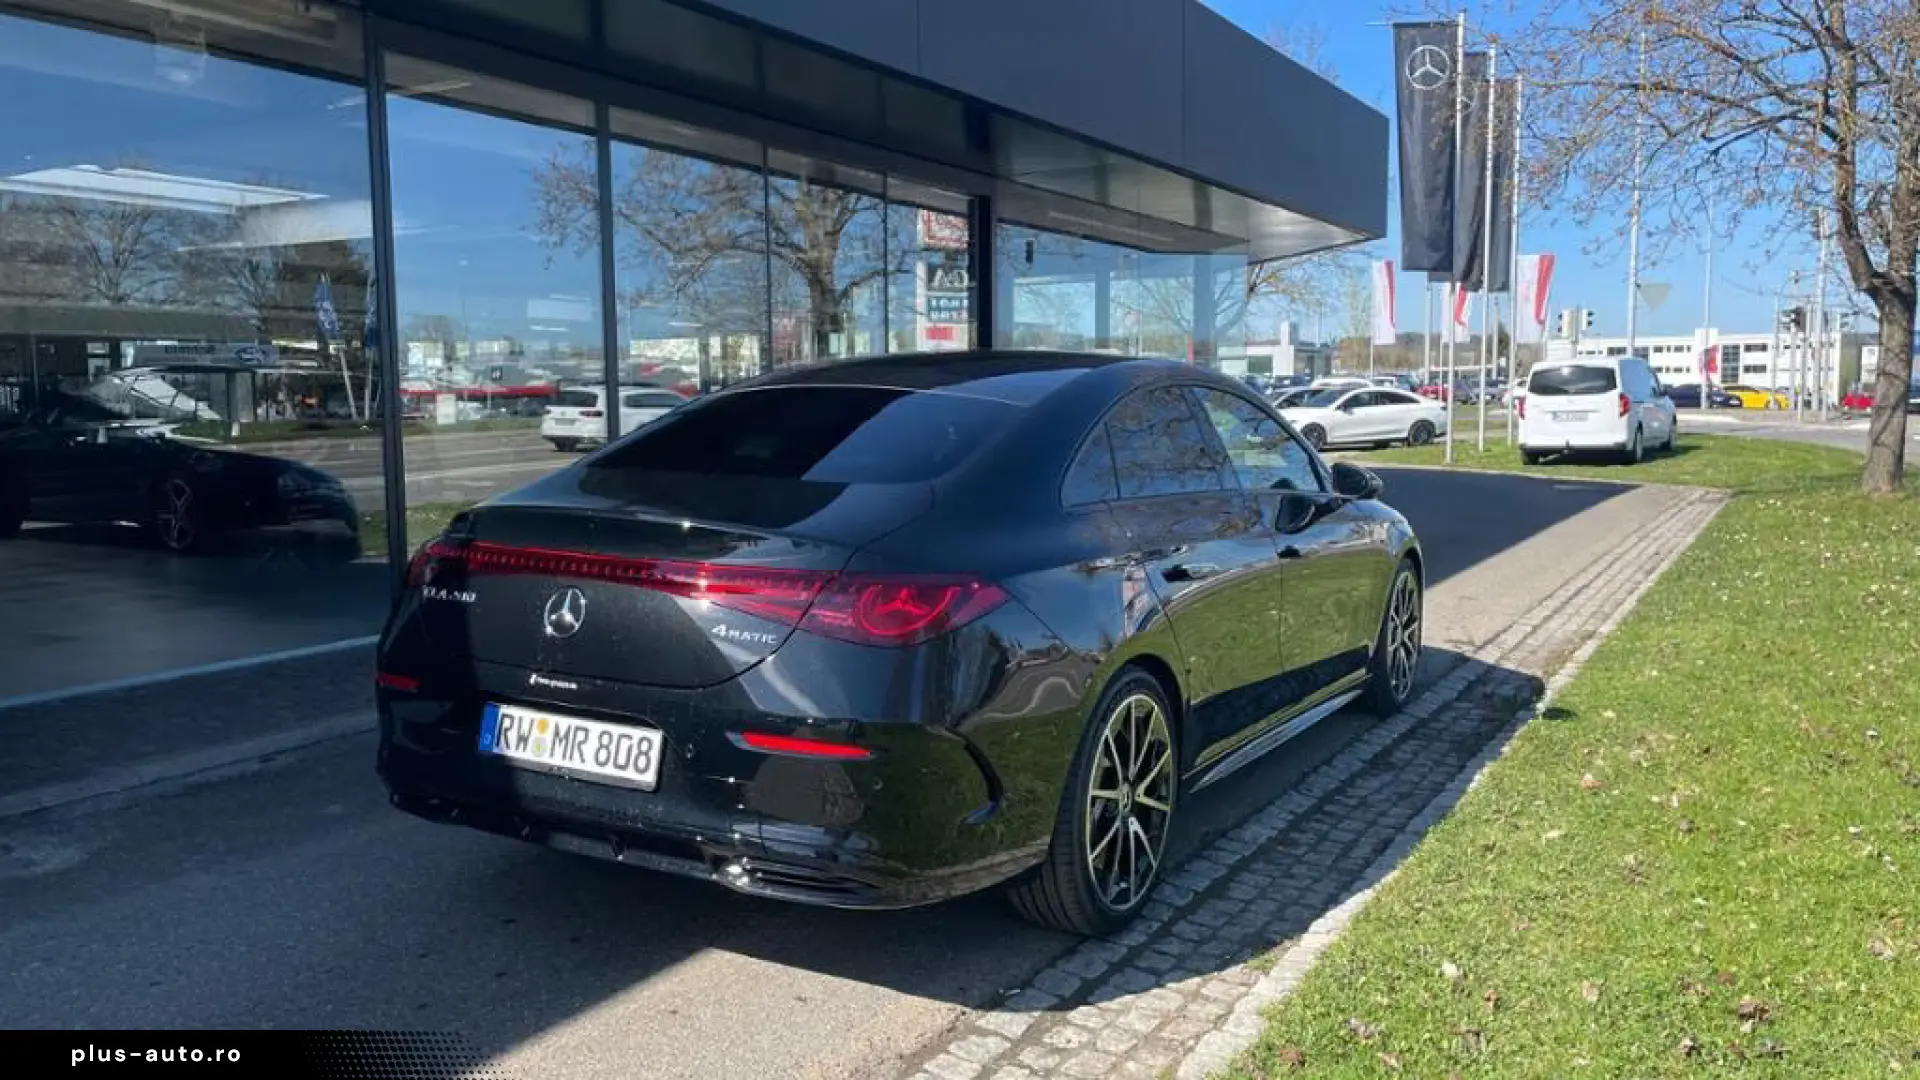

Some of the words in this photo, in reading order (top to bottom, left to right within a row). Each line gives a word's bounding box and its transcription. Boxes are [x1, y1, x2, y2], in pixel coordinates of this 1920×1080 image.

[711, 624, 777, 644] 4MATIC
[495, 713, 535, 753] RW
[550, 720, 590, 764] MR
[594, 730, 654, 775] 808
